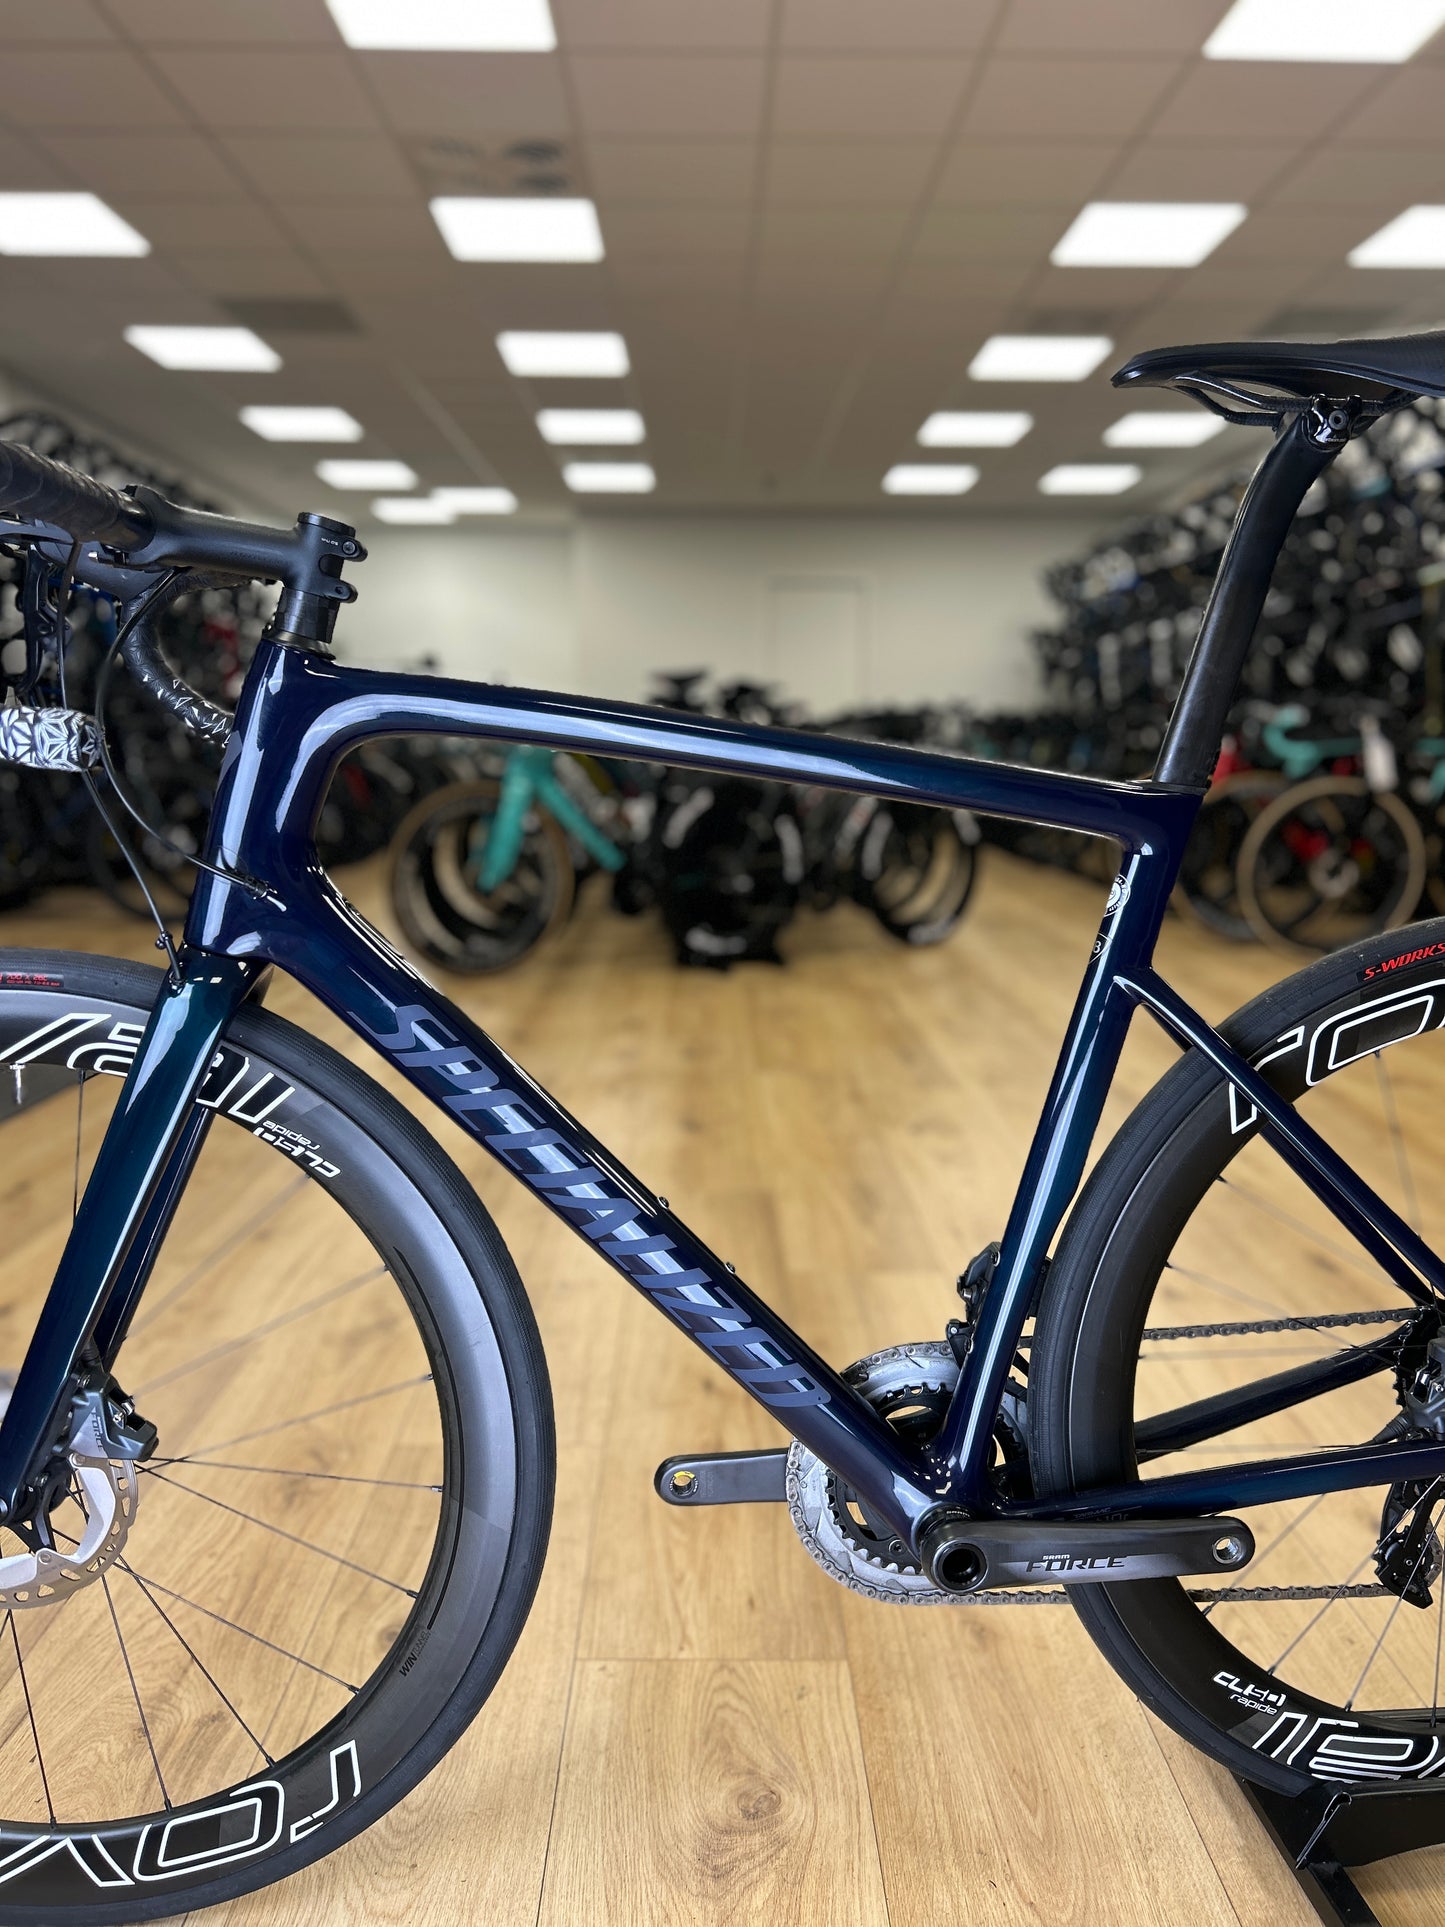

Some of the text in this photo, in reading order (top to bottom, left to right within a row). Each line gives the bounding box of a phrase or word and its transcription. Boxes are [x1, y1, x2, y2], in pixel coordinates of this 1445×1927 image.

[1362, 942, 1445, 981] S-WORKS
[262, 1120, 321, 1151] rapide
[347, 1004, 831, 1407] SPECIALIZED
[1026, 1555, 1128, 1573] FORCE
[1230, 1694, 1278, 1716] rapide
